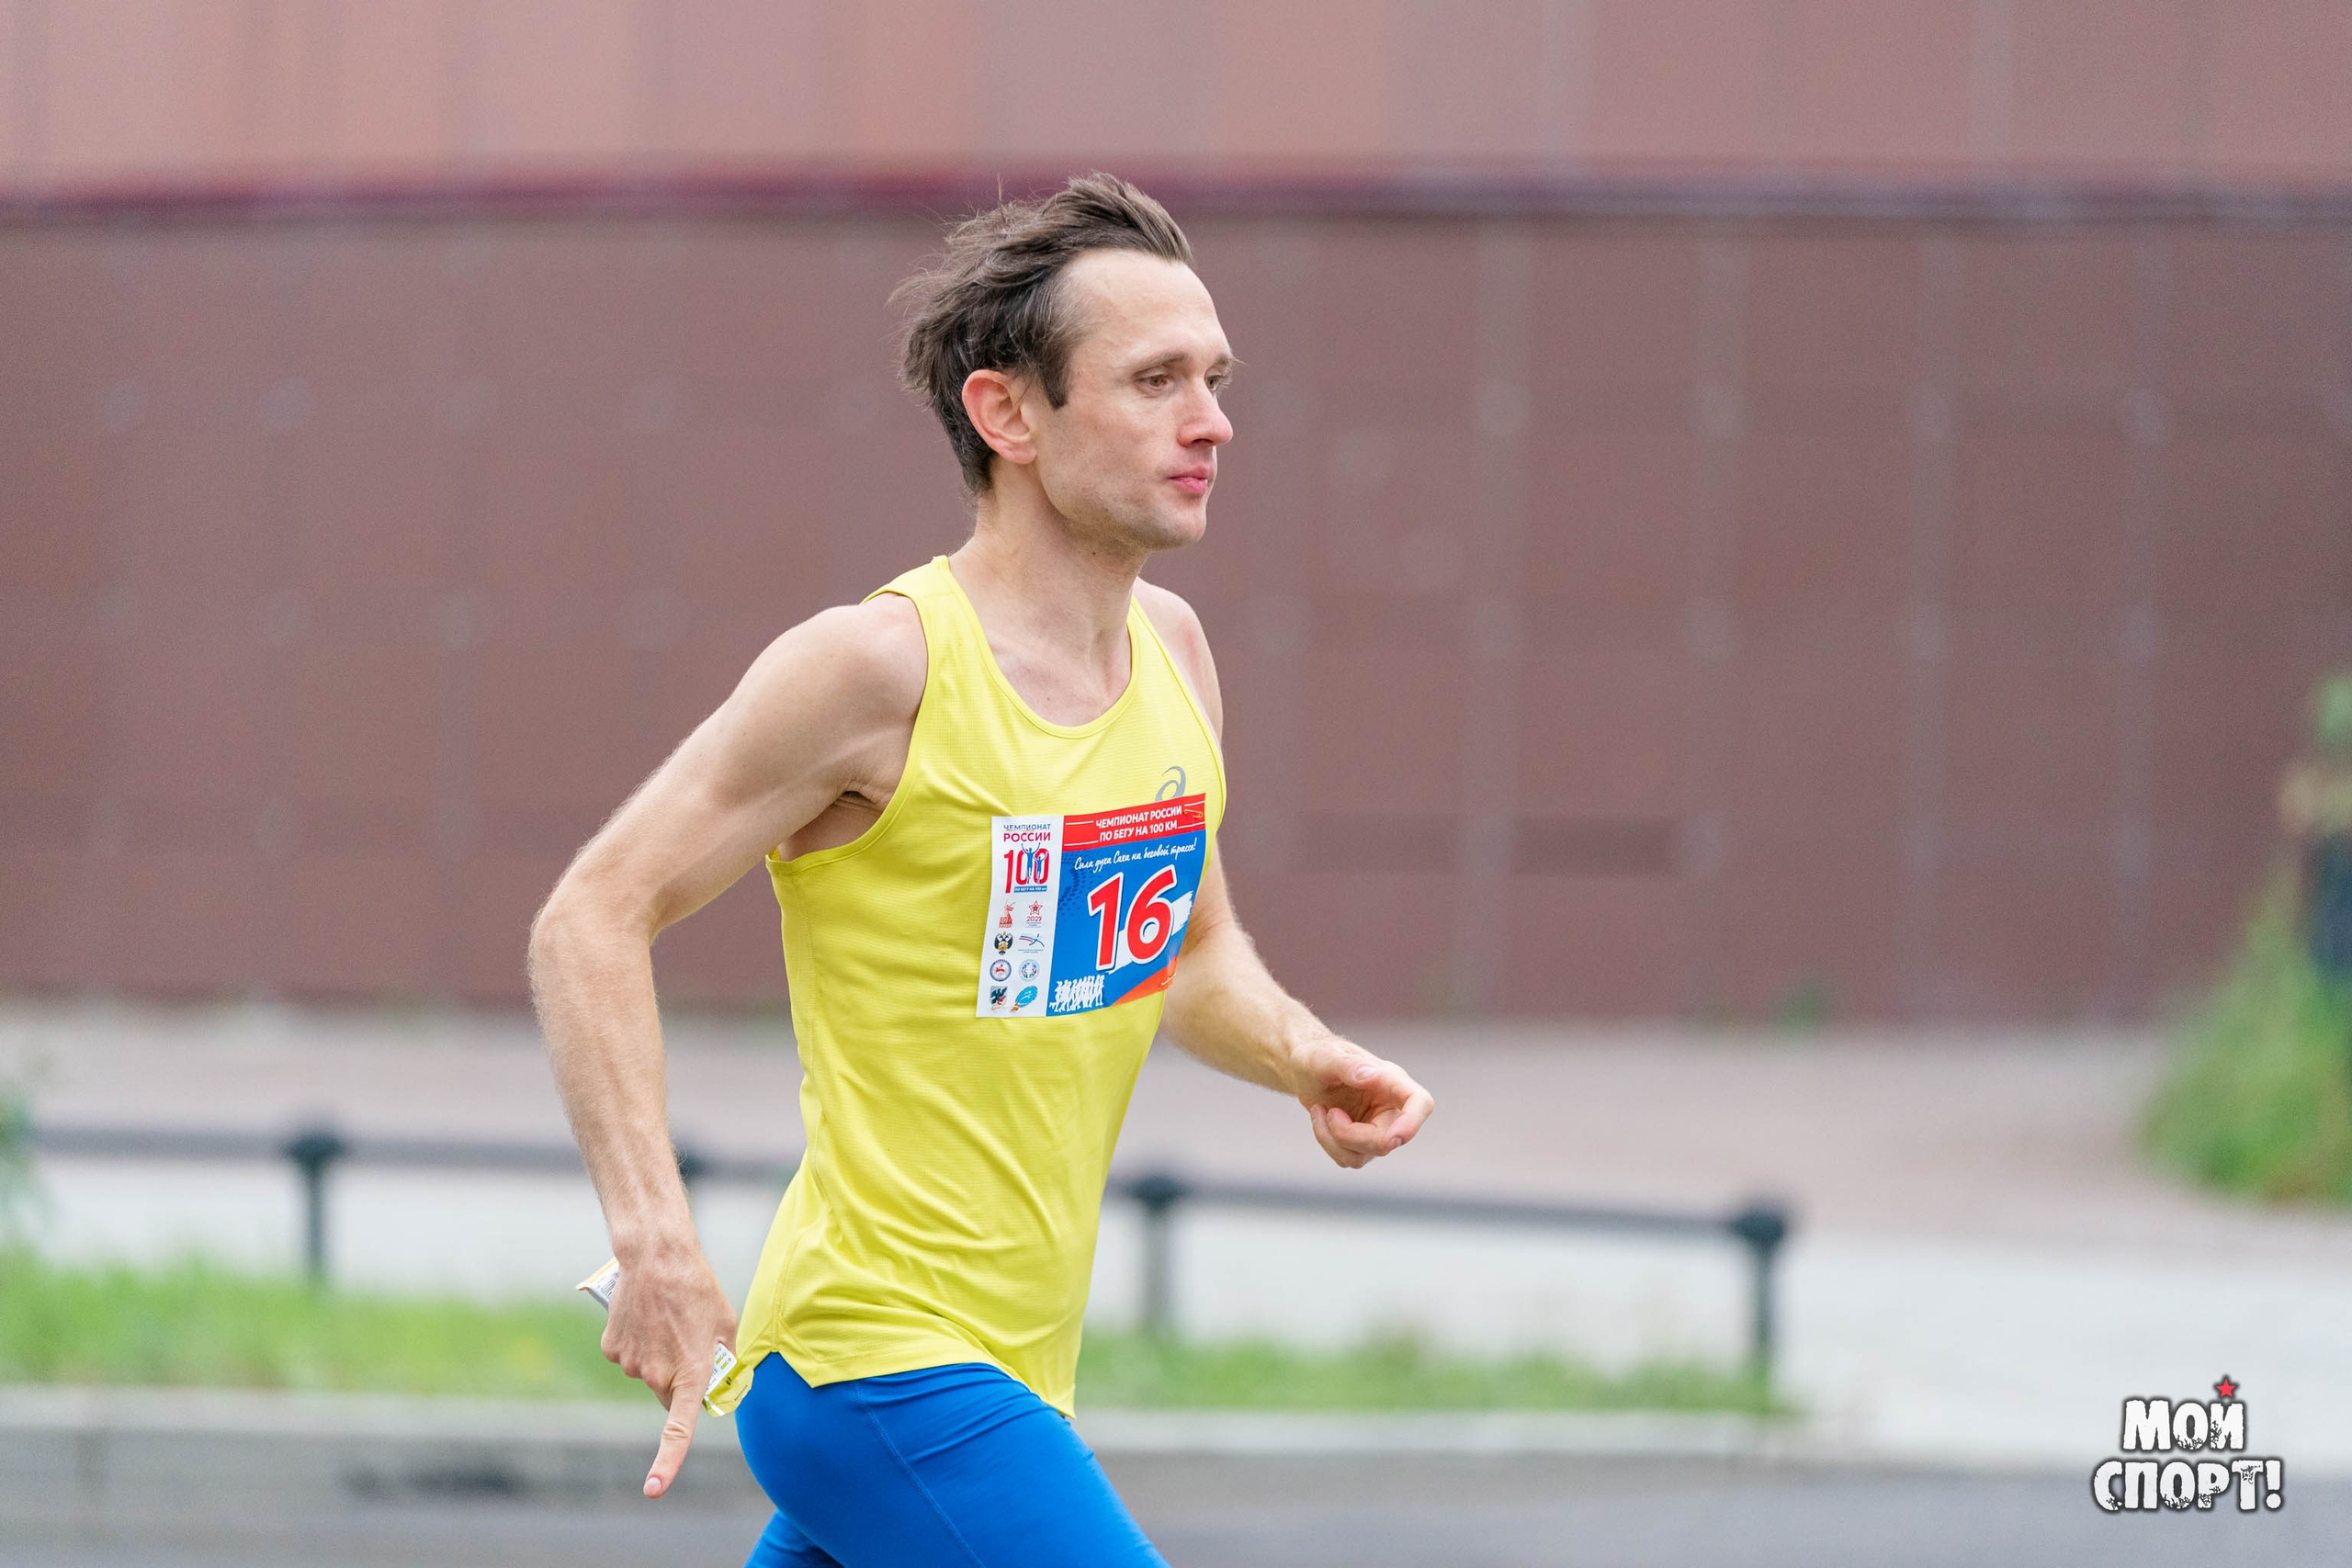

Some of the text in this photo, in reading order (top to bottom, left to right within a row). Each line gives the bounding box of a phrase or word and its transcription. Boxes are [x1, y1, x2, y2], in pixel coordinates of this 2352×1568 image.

[1096, 806, 1182, 829] ЧЕМПИОНАТ РОССИИ
[1100, 820, 1178, 842] ПО БЕГУ НА 100 КМ
[1003, 832, 1051, 842] РОССИИ
[1074, 837, 1197, 874] Сила духа Саха на беговой трассе!
[1003, 848, 1050, 894] 100
[1088, 865, 1177, 969] 16
